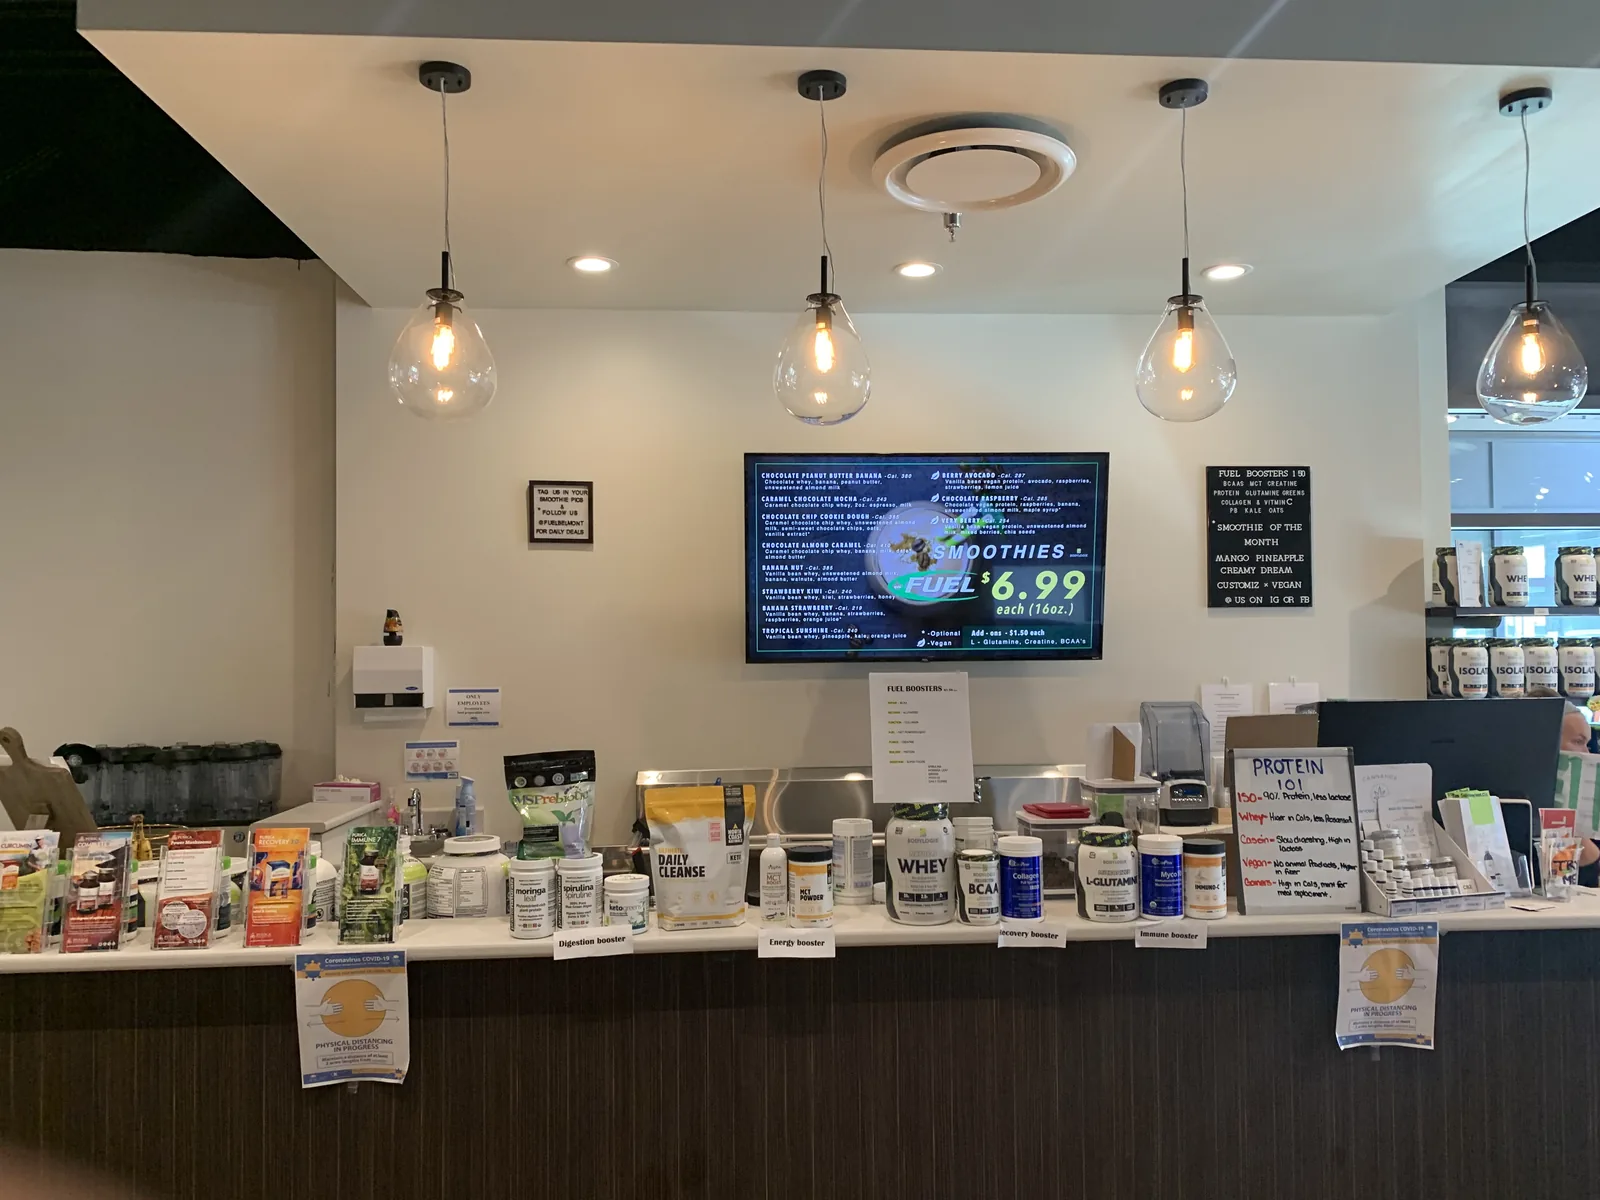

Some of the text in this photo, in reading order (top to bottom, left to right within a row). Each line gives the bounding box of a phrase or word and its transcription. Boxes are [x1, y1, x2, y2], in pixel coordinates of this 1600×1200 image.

[933, 544, 1065, 559] SMOOTHIES
[905, 577, 975, 593] FUEL
[996, 603, 1074, 616] each (16oz.)
[1253, 758, 1324, 776] PROTEIN
[1278, 778, 1302, 791] 101
[1328, 792, 1352, 801] lactose
[658, 854, 688, 866] DAILY
[897, 857, 948, 874] WHEY
[659, 866, 705, 878] CLEANSE
[516, 887, 546, 896] moringa
[564, 884, 594, 892] spirulina
[1031, 931, 1058, 939] booster
[559, 936, 626, 948] Digestion booster
[770, 938, 825, 947] Energy booster
[316, 1040, 350, 1049] PHYSICAL
